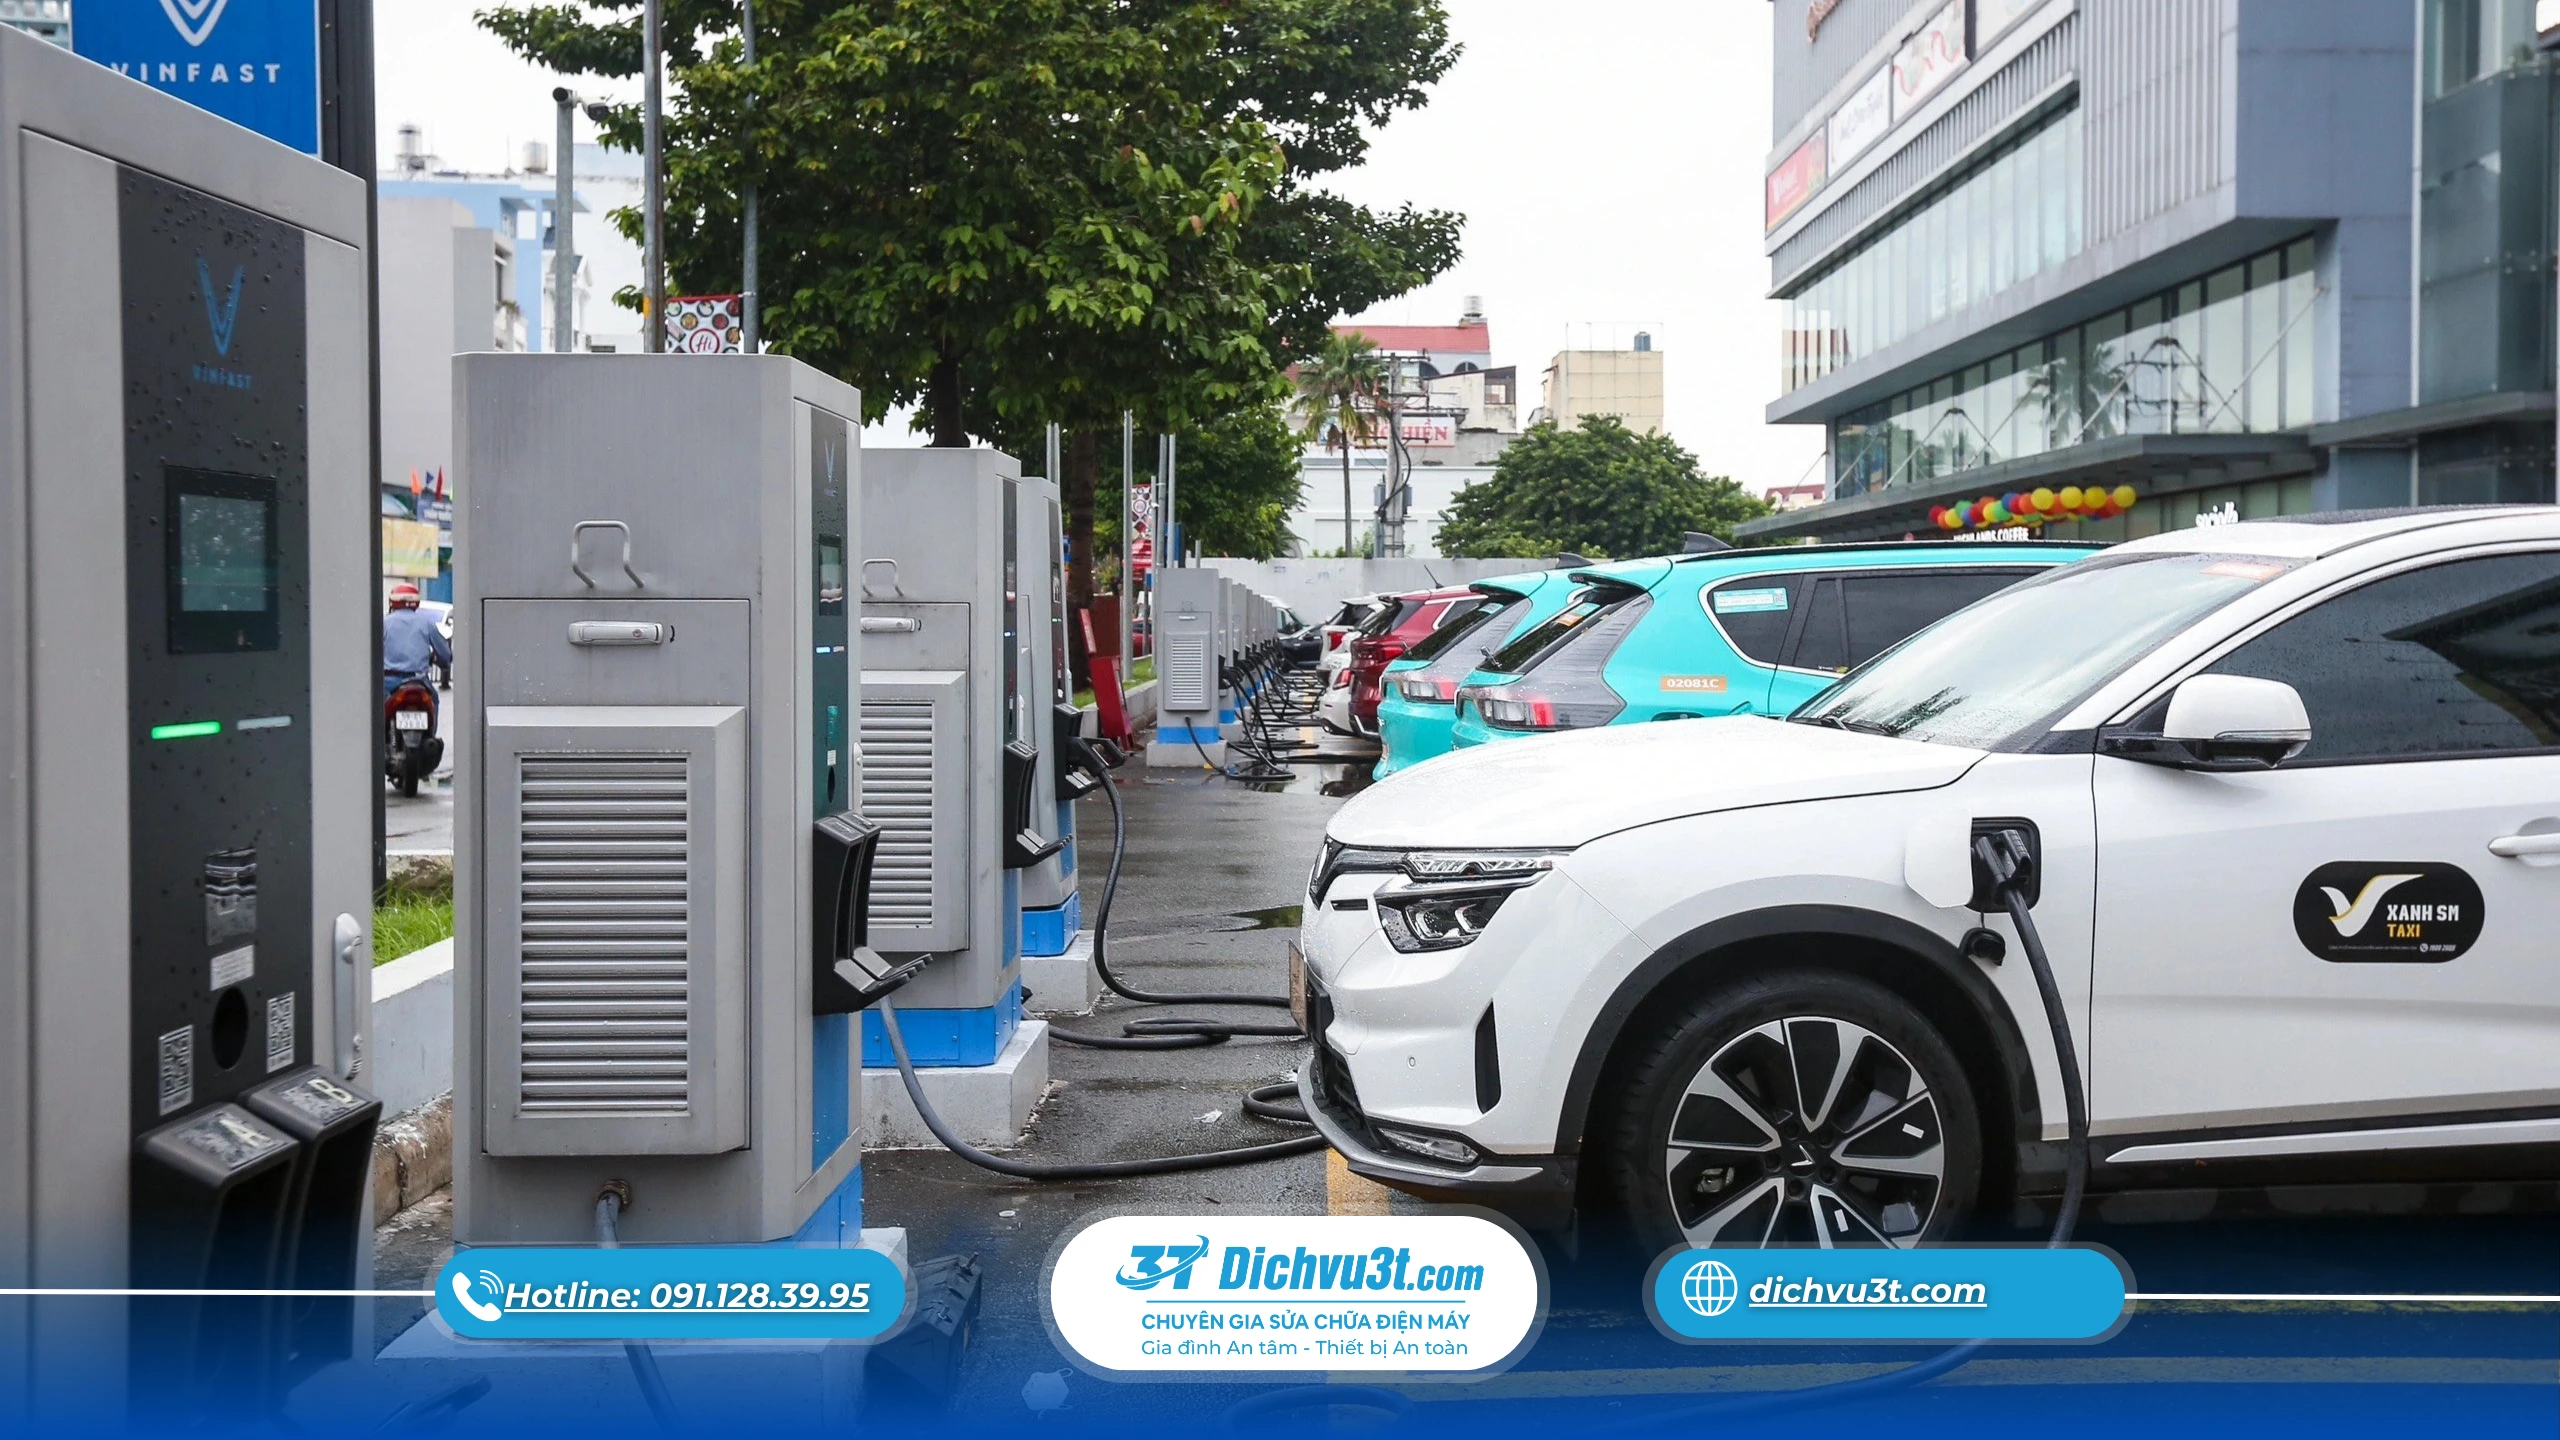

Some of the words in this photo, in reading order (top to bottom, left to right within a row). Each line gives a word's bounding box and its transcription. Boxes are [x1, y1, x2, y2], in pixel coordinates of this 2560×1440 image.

[110, 62, 281, 83] VINFAST
[1998, 526, 2029, 541] COFFEE
[1666, 679, 1719, 688] 02081C
[2387, 904, 2433, 921] XANH
[2436, 904, 2460, 921] SM
[2387, 923, 2421, 938] TAXI
